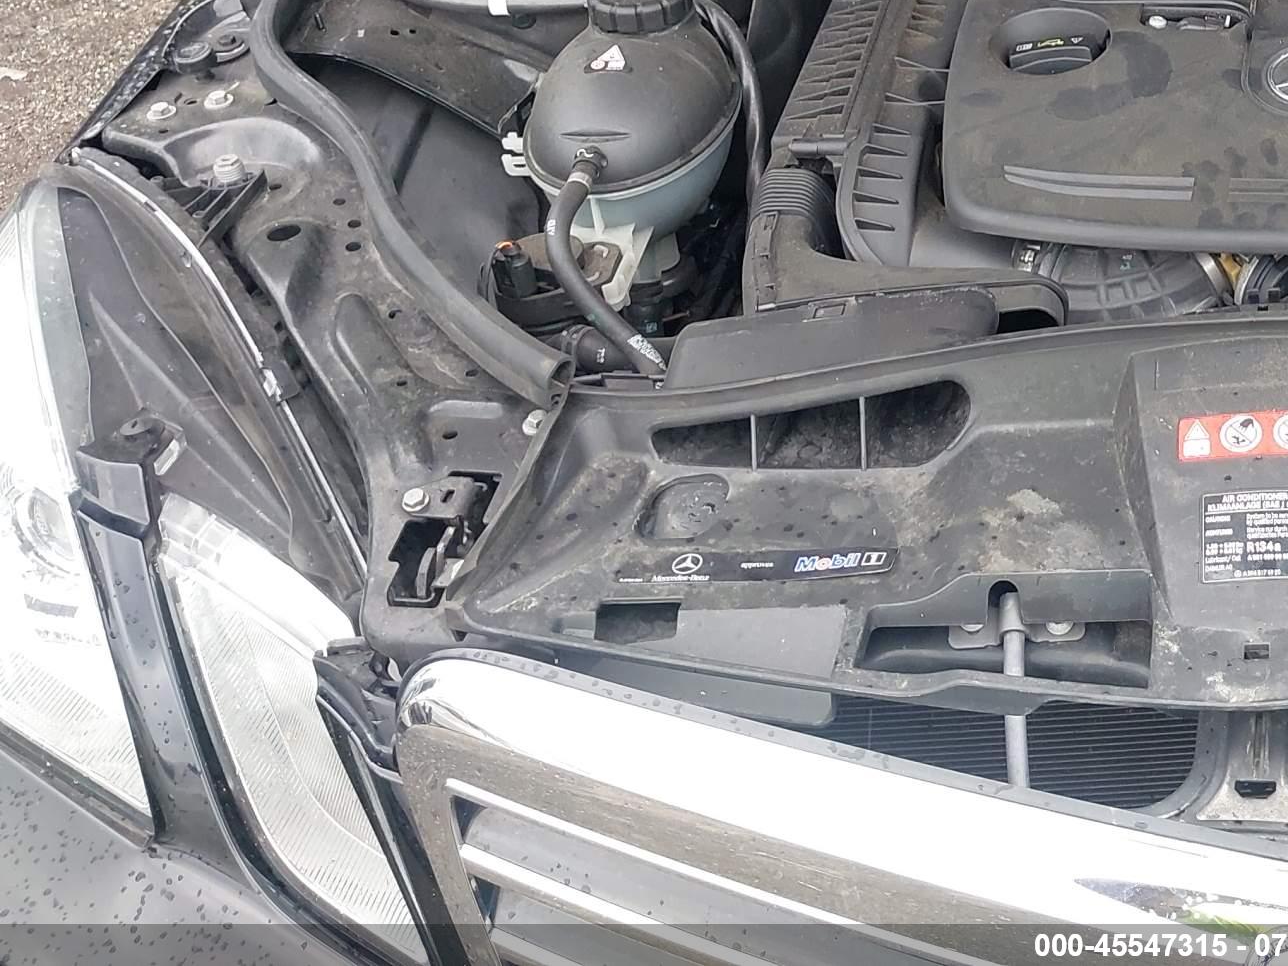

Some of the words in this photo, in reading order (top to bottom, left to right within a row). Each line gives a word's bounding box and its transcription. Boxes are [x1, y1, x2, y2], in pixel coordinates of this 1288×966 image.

[1222, 494, 1235, 503] AIR
[1237, 492, 1288, 502] CONDITIONER
[794, 552, 861, 572] Mobil
[651, 574, 710, 583] Mercedes-Benz
